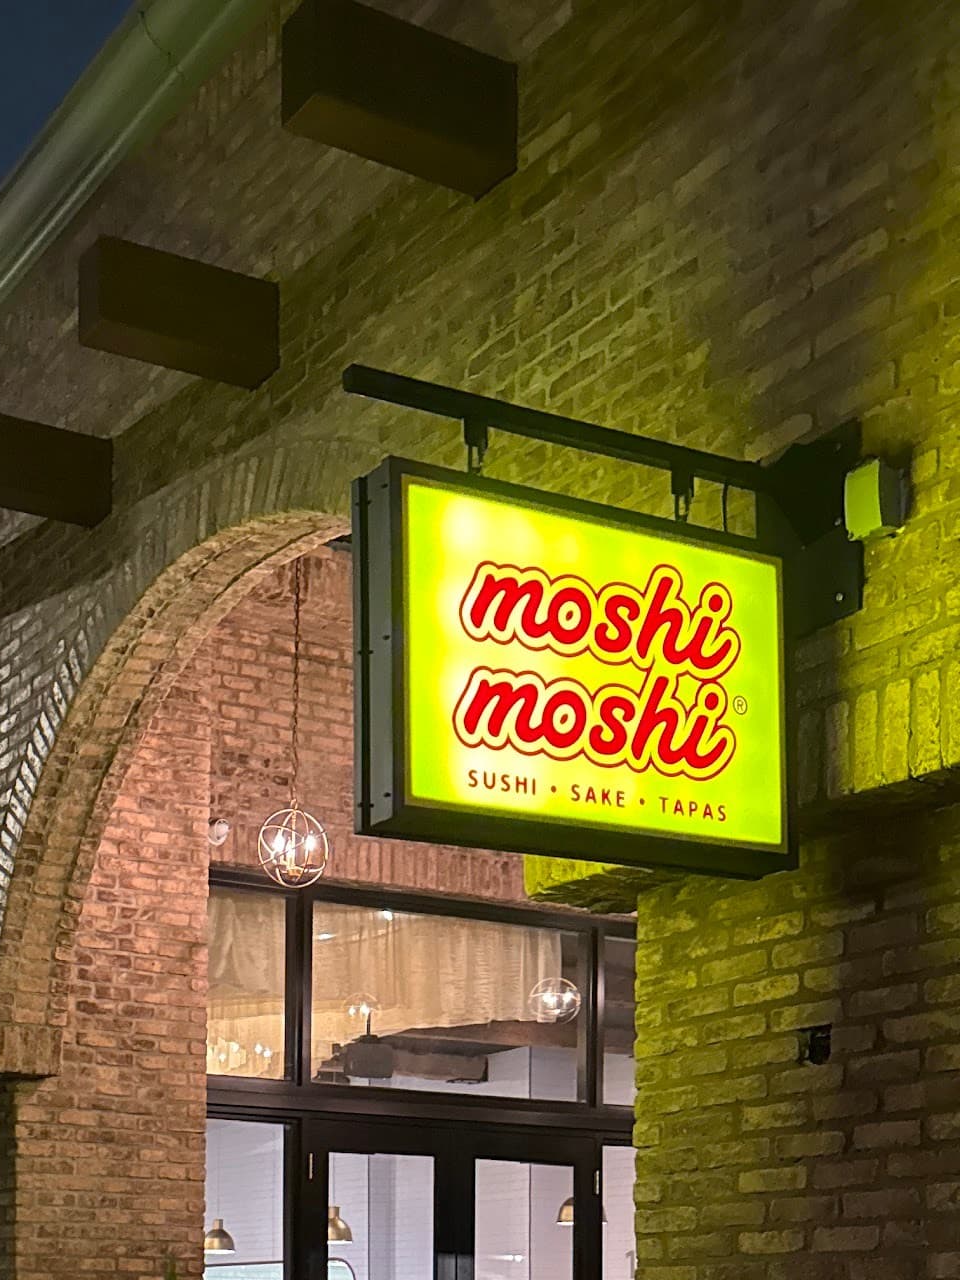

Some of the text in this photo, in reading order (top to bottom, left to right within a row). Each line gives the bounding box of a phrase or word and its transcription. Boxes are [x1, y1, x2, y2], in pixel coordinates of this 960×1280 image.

[469, 572, 732, 670] moshi
[463, 675, 728, 769] moshi
[468, 769, 727, 822] SUSHI SAKE TAPAS
